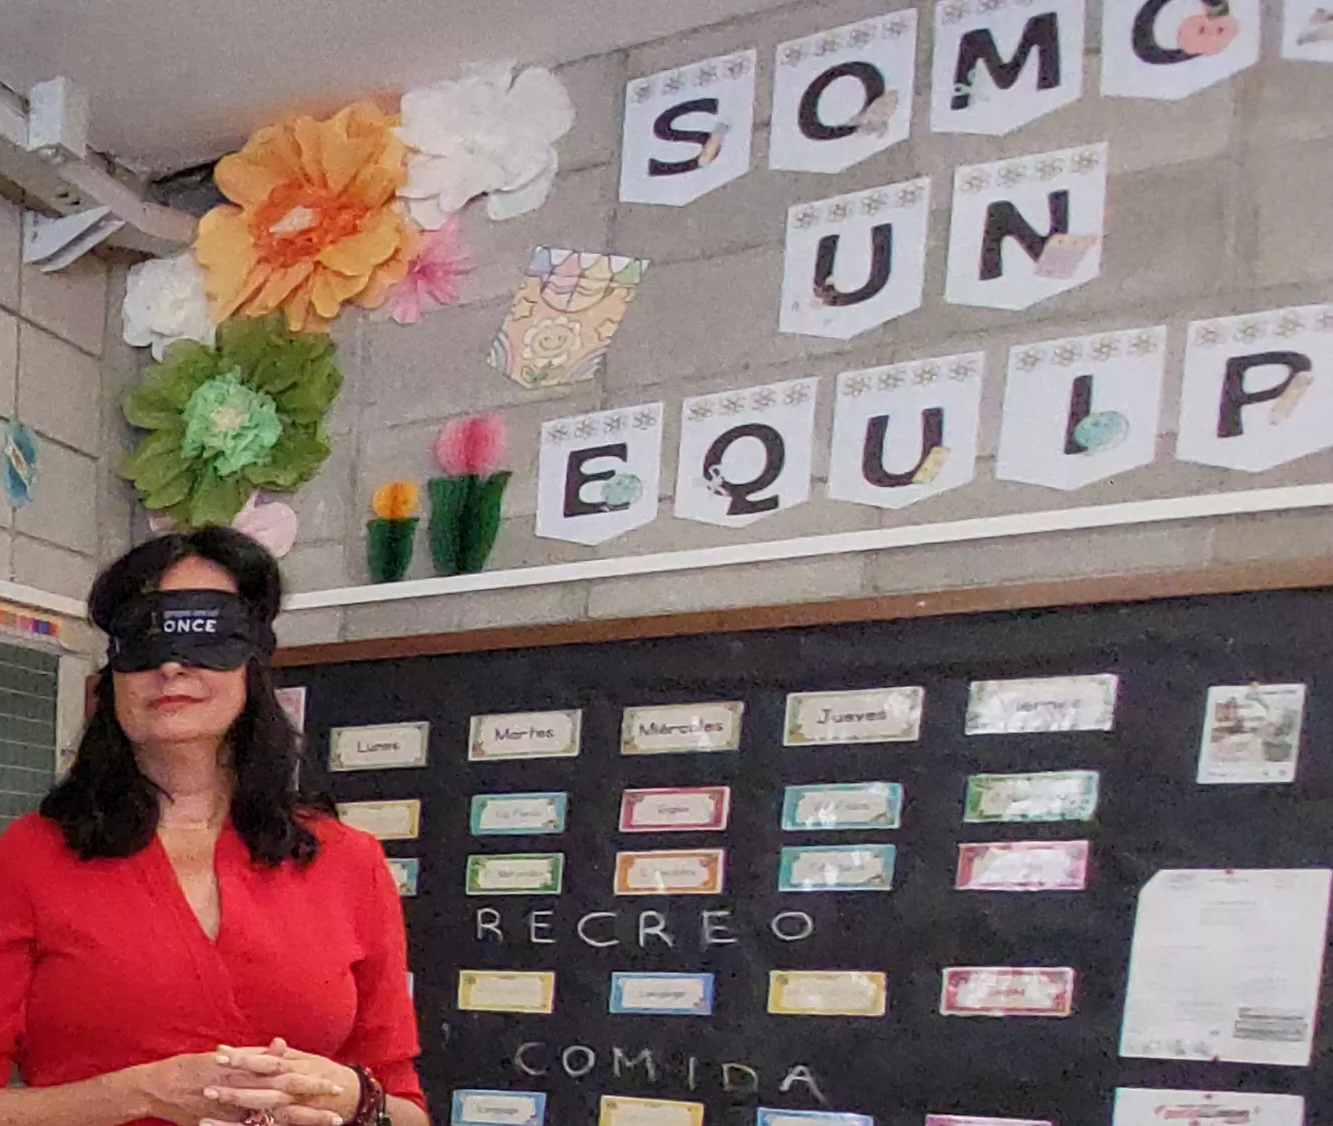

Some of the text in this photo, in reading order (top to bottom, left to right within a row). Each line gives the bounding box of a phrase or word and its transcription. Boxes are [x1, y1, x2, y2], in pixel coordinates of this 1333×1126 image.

[813, 189, 1070, 307] UN
[563, 350, 1313, 519] EQUIP
[163, 619, 218, 633] ONCE
[494, 726, 555, 741] Martes
[816, 706, 887, 724] Jueves
[476, 907, 814, 950] RECREO
[513, 1041, 830, 1105] COMIDA
